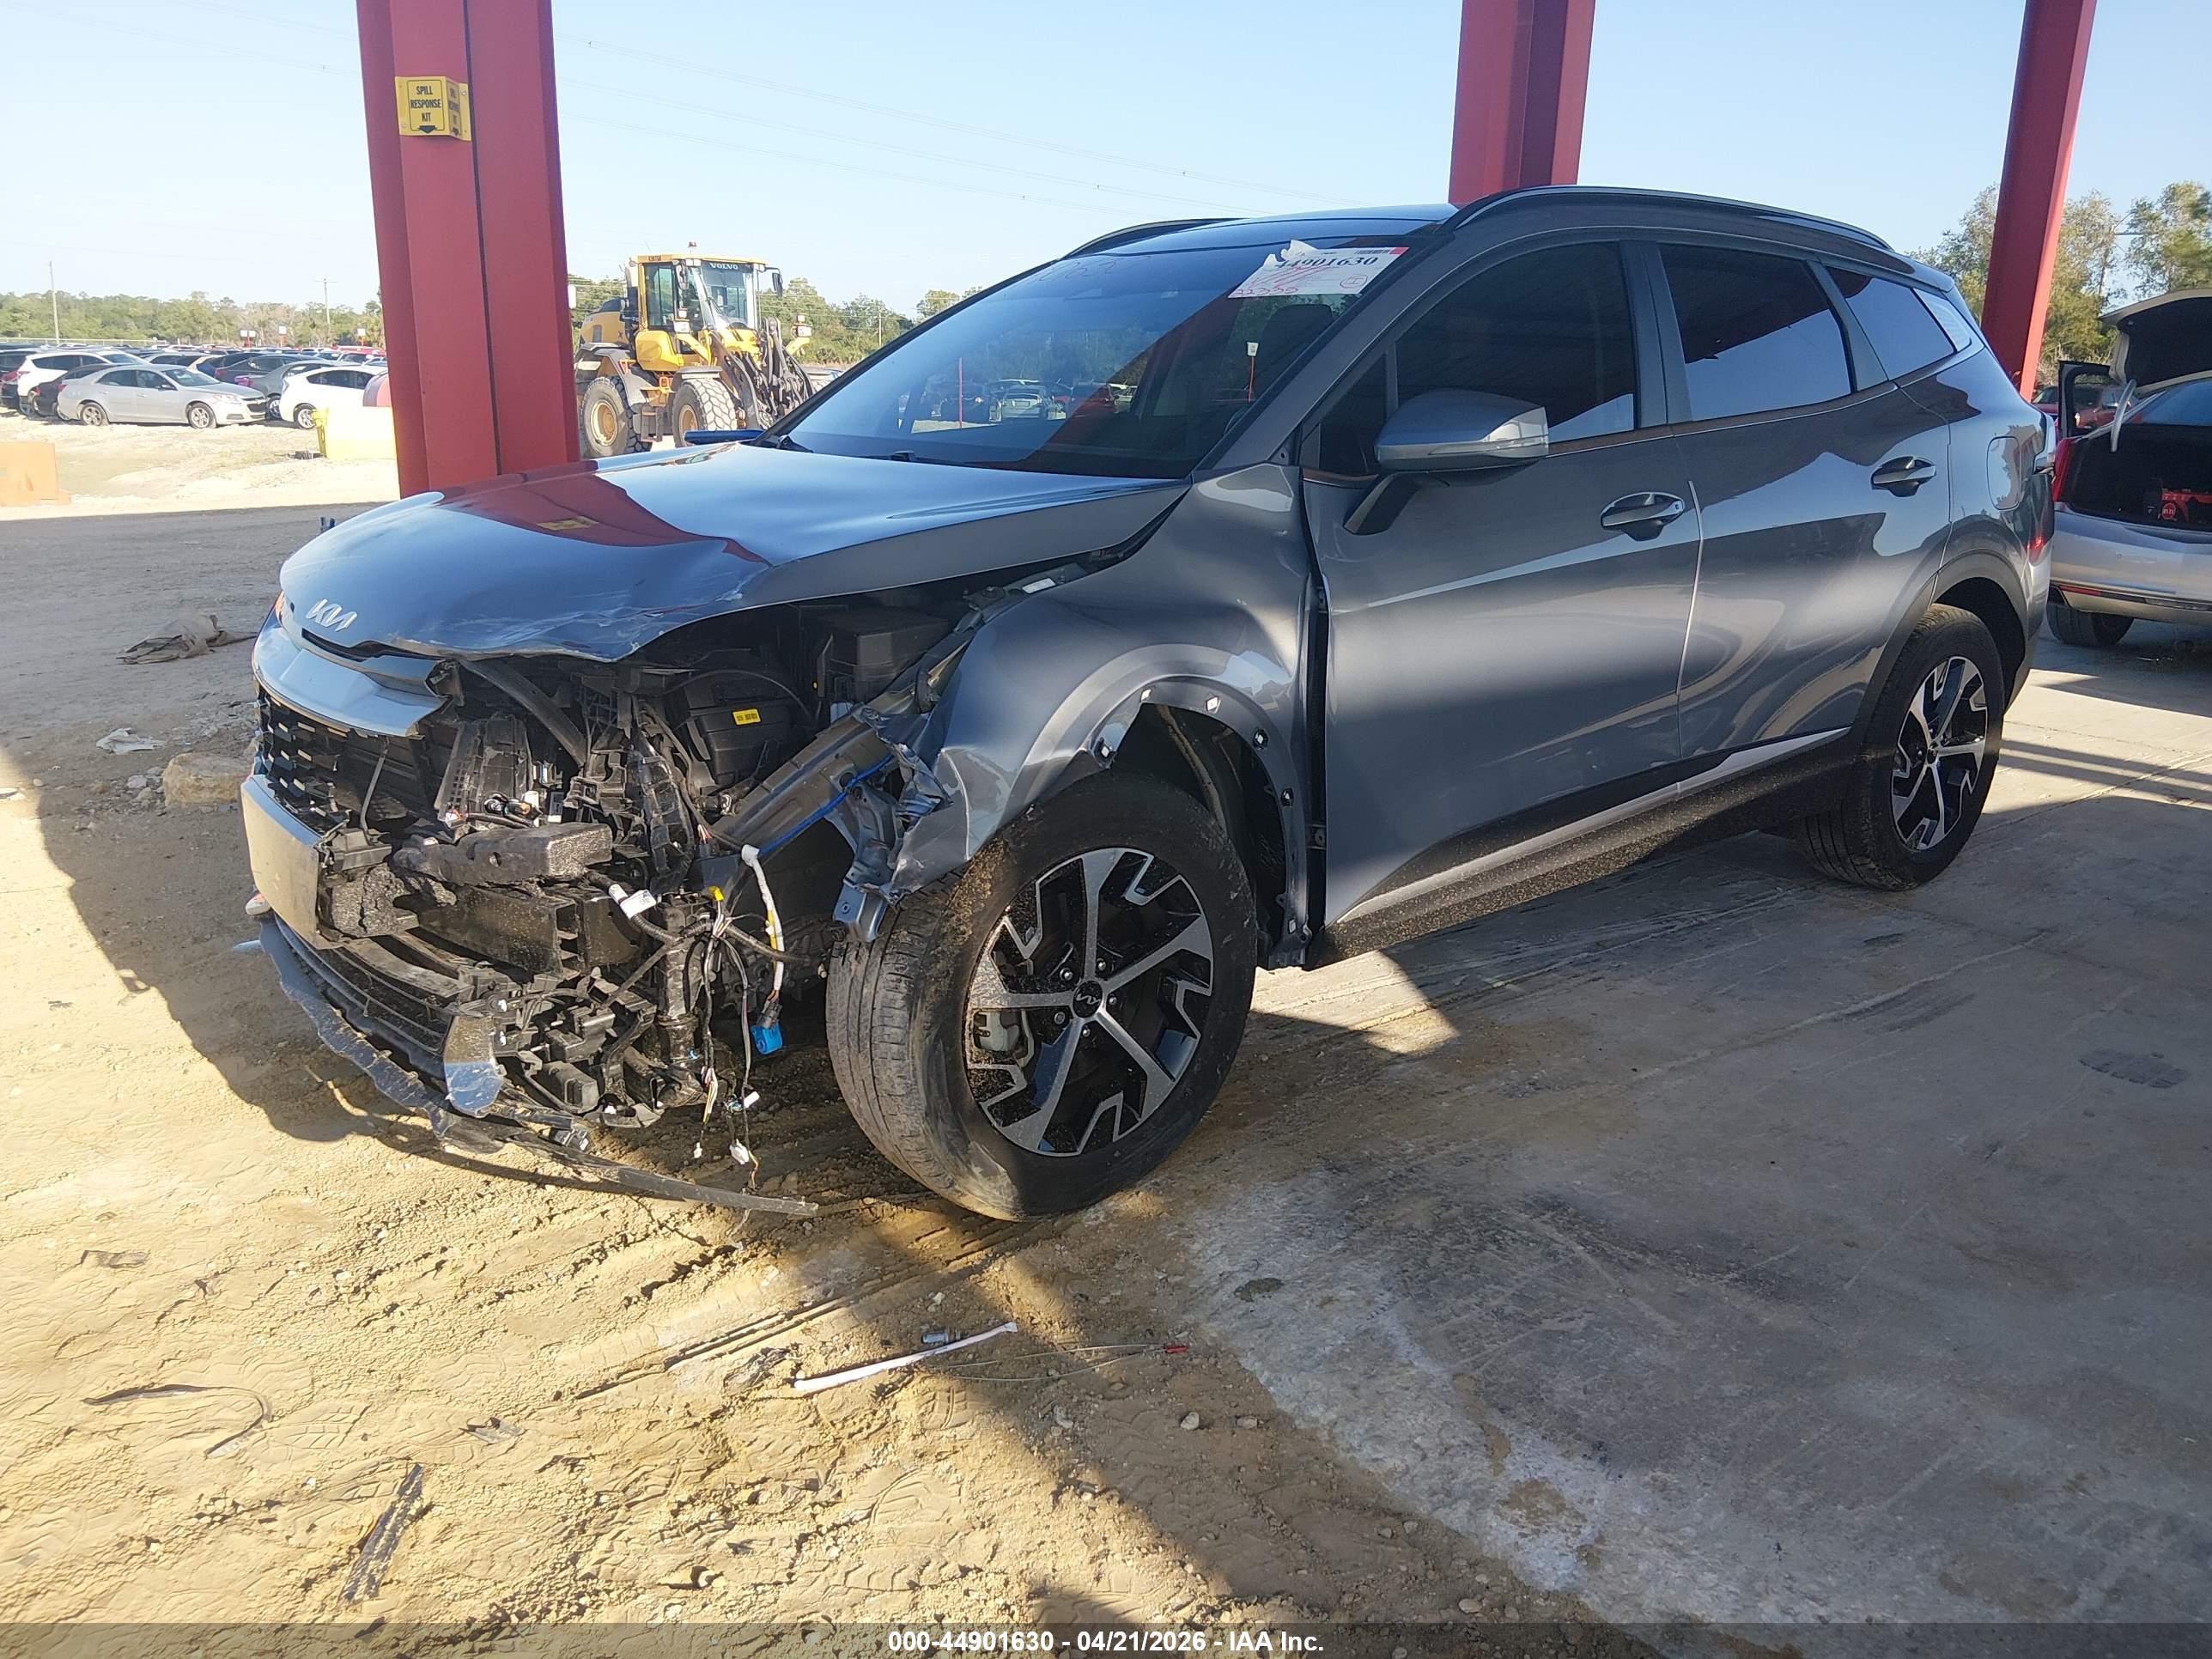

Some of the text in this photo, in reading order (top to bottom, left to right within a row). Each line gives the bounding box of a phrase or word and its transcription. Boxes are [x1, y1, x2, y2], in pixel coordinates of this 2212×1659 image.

[416, 86, 433, 95] SPILL
[410, 99, 441, 108] RESPONSE
[421, 112, 432, 122] KIT
[1274, 257, 1378, 268] 44901630
[305, 599, 358, 632] KIA
